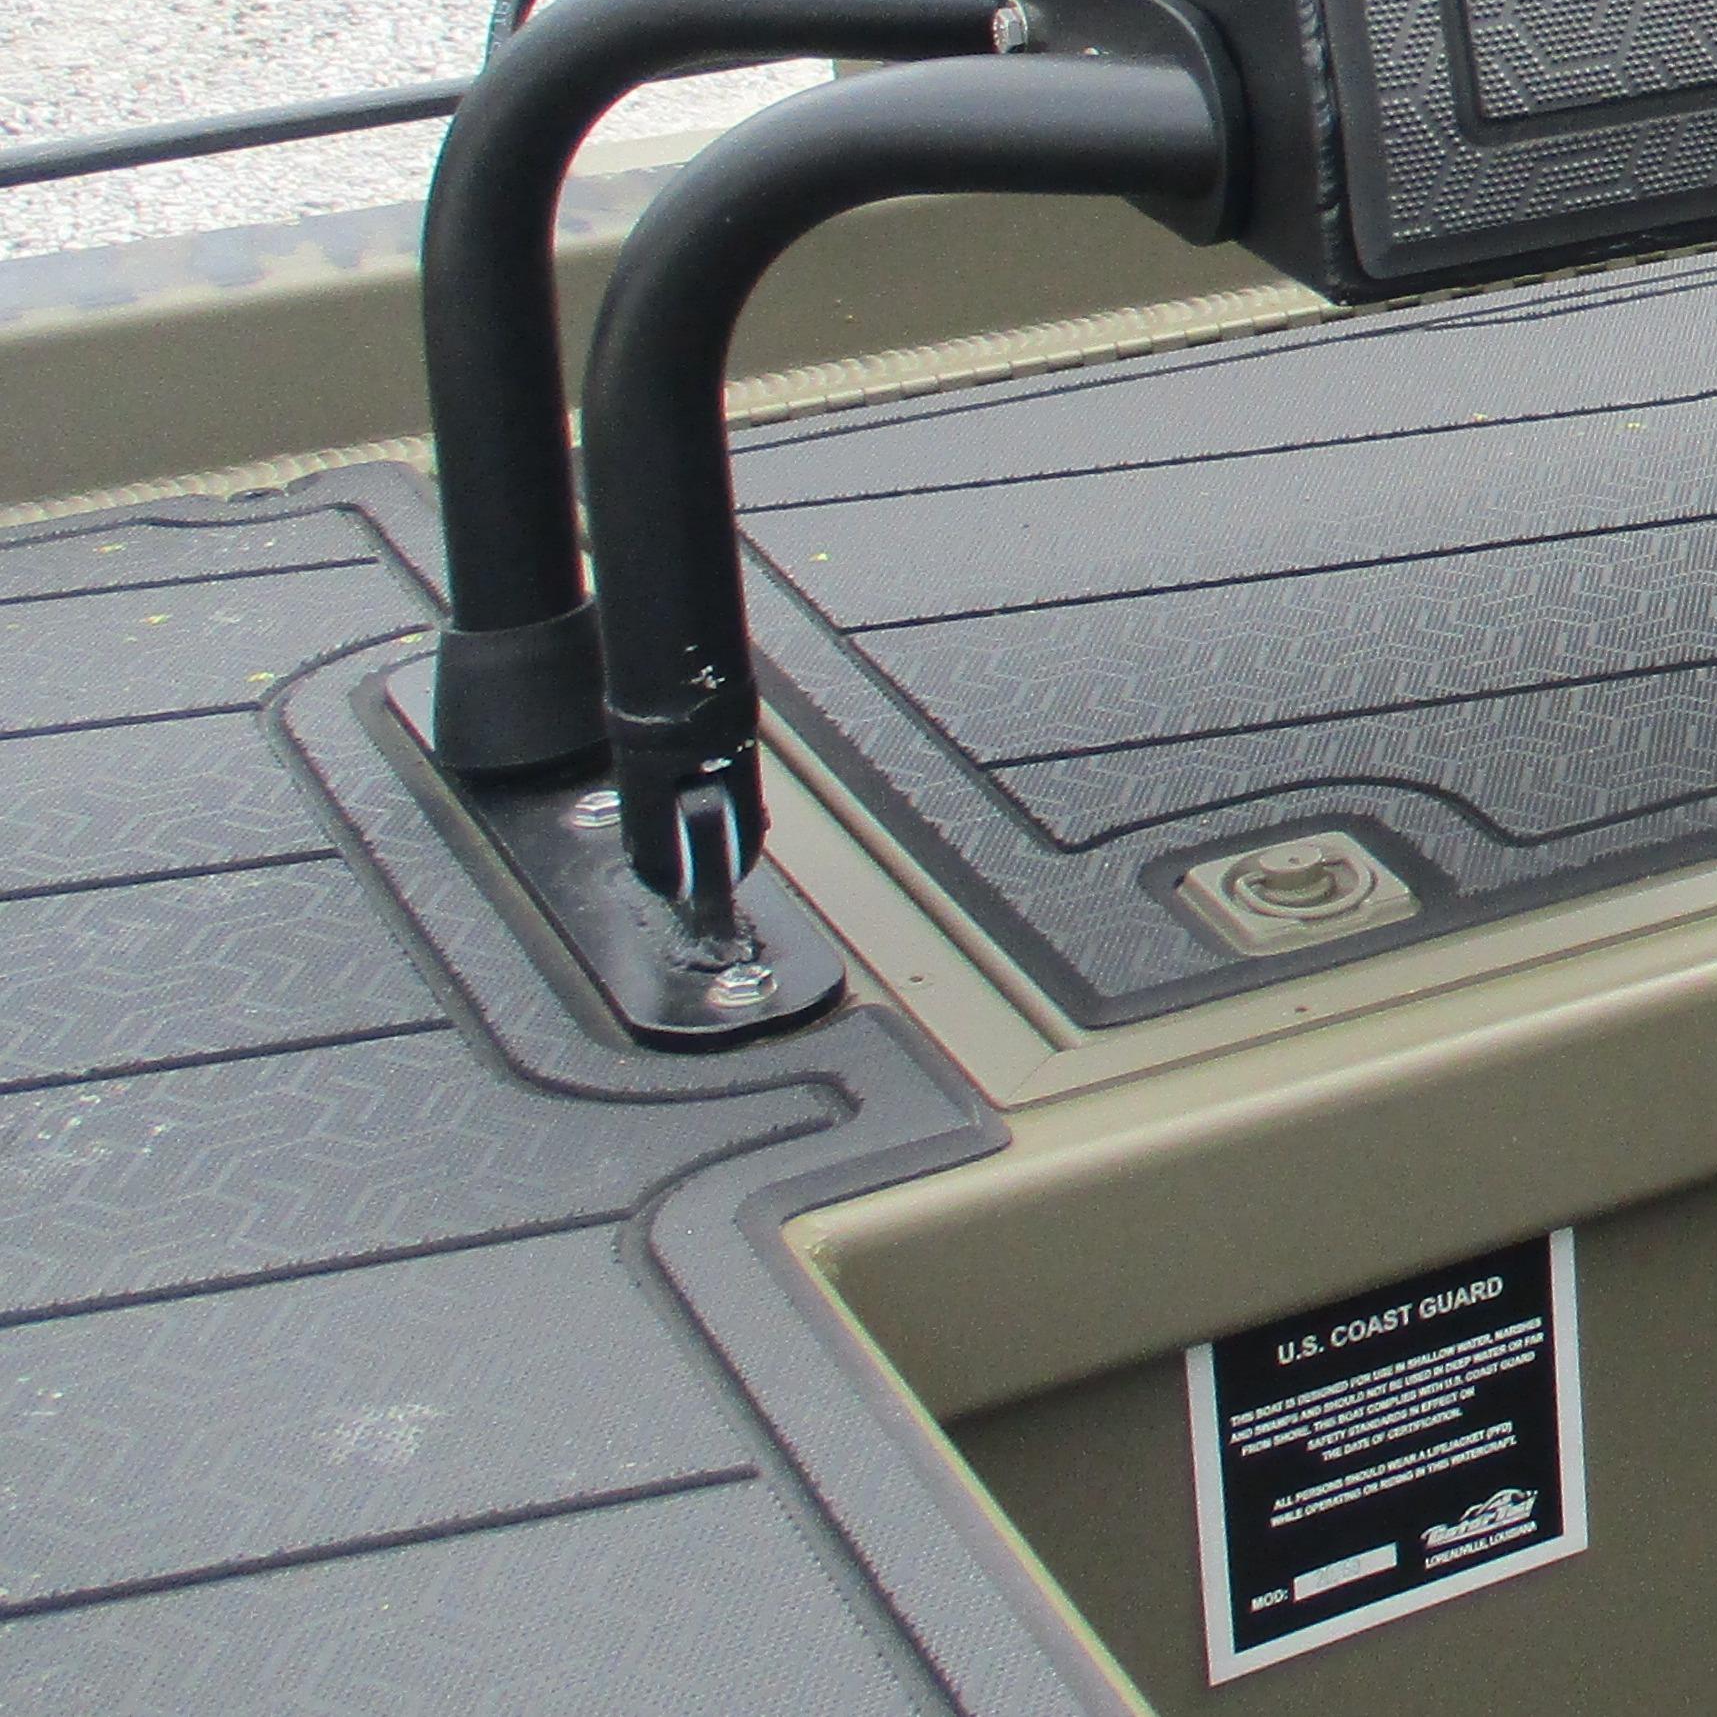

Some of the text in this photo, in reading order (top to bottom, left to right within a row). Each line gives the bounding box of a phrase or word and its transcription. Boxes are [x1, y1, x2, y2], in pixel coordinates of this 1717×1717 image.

[1278, 1276, 1504, 1365] U.S. COAST GUARD
[1250, 1585, 1289, 1612] MOD:
